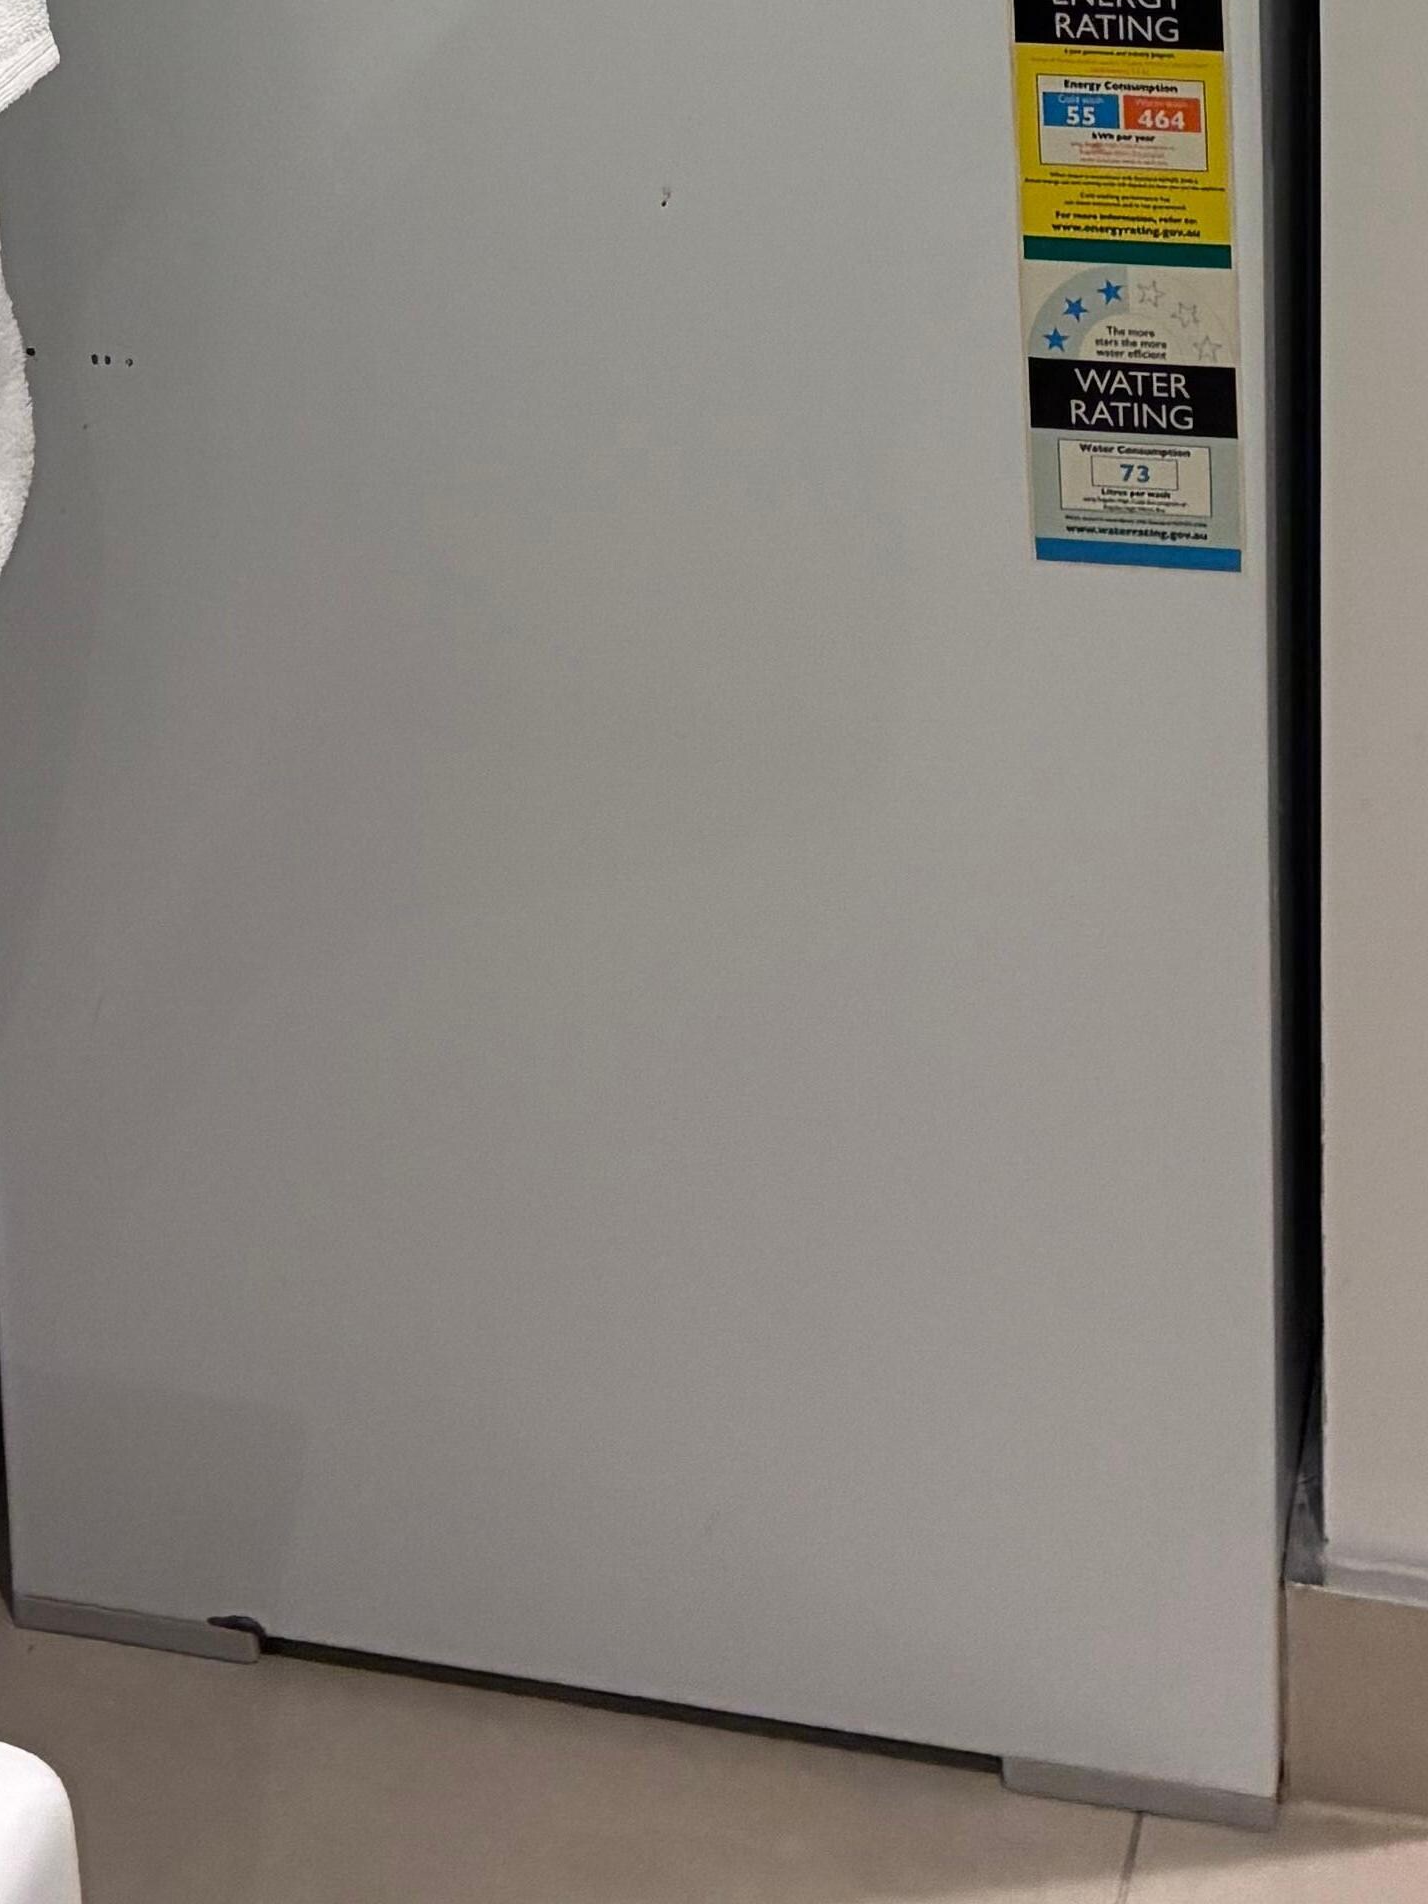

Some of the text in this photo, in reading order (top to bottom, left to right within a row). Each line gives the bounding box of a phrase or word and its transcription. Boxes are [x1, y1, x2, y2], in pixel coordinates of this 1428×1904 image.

[1054, 12, 1179, 42] RATING
[1063, 79, 1178, 94] Energy Consumption
[1066, 106, 1185, 130] 55 464
[1091, 132, 1156, 144] kWh per year
[1055, 211, 1071, 220] For
[1073, 212, 1097, 221] more
[1052, 223, 1201, 239] www.energyrating.gov.au
[1106, 325, 1155, 338] The more
[1095, 338, 1167, 349] stars the more
[1096, 349, 1167, 360] water efficient
[1074, 368, 1190, 399] WATER
[1070, 400, 1194, 430] RATING
[1079, 443, 1191, 459] Water Consumption
[1120, 464, 1151, 483] 73
[1066, 525, 1208, 541] www.waterrating.gov.au
